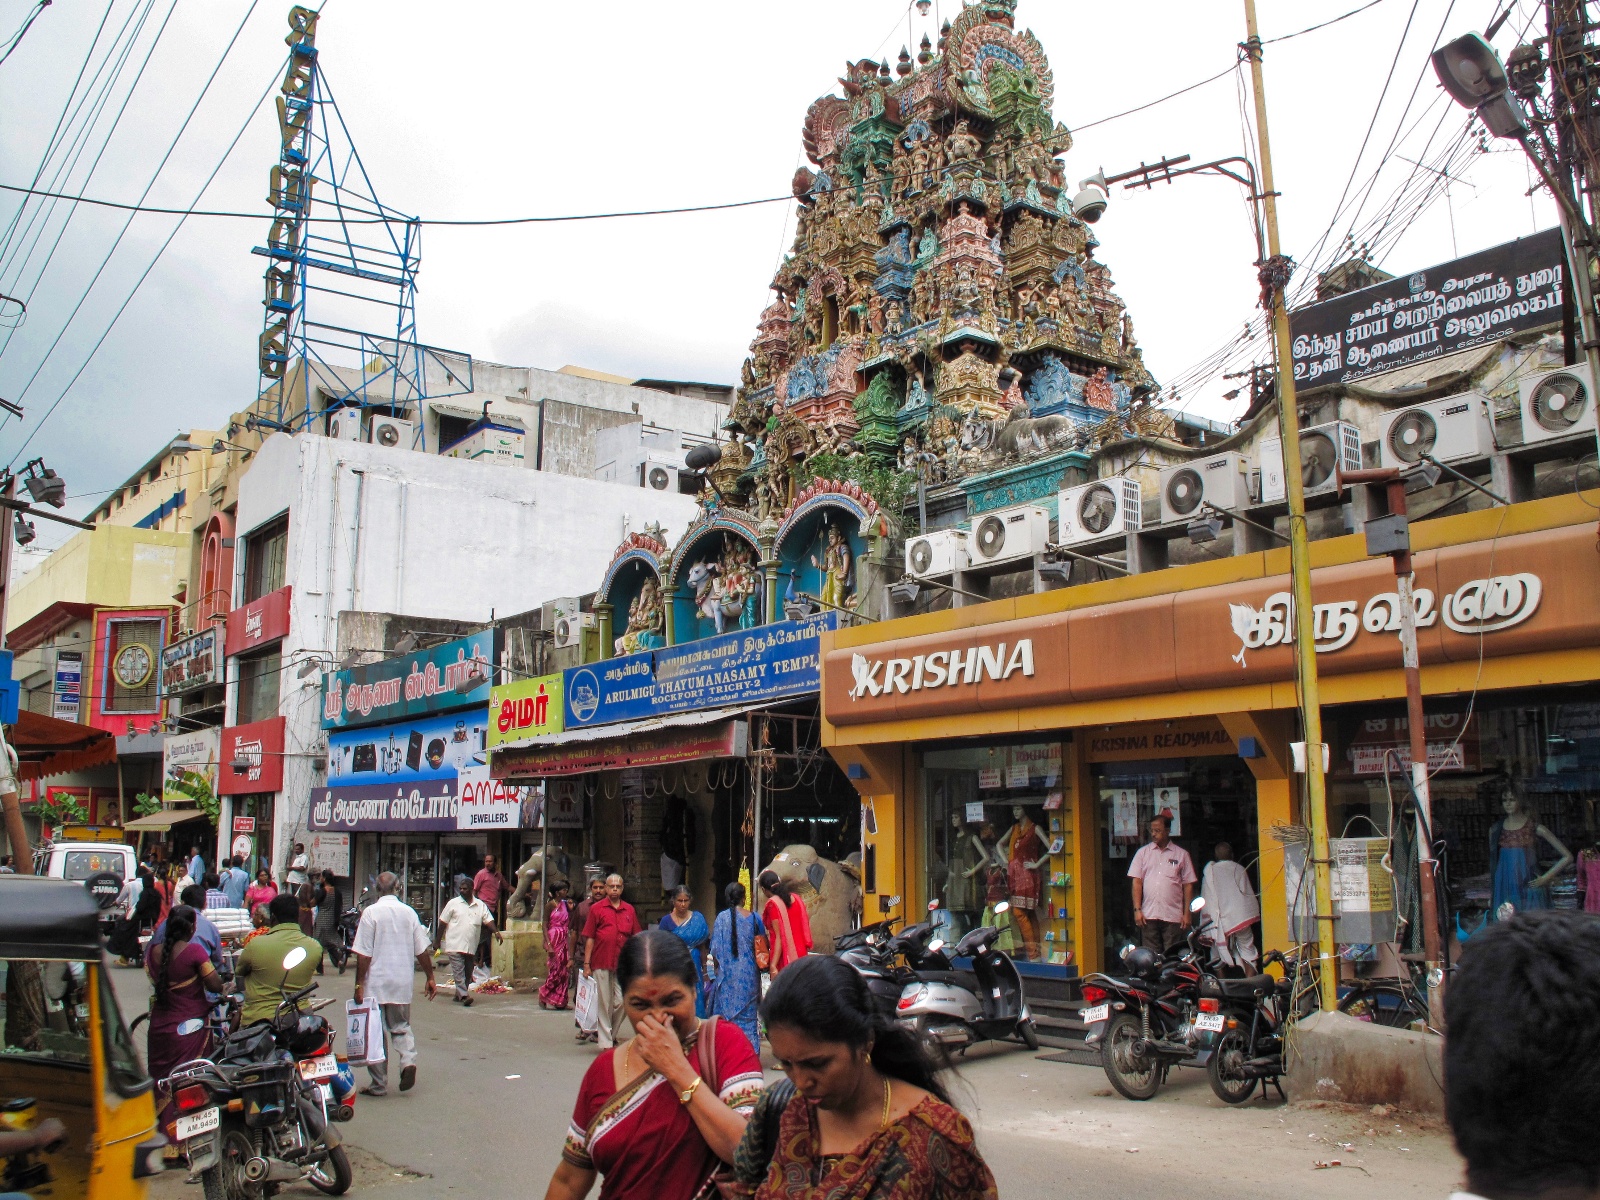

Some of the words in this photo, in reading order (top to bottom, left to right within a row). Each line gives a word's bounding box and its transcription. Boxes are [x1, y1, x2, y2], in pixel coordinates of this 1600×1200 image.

[1292, 331, 1342, 360] இந்து
[1345, 317, 1388, 344] சமய
[1392, 276, 1512, 329] அறநிலையத்
[1350, 289, 1436, 325] தமிழ்நாடு
[1442, 272, 1493, 293] அரசு
[1293, 350, 1342, 382] உதவி
[1346, 321, 1440, 367] ஆணையர்
[1340, 344, 1443, 383] திருச்சிராப்பள்ளி
[1456, 336, 1485, 349] 620
[1486, 328, 1516, 340] 002
[603, 660, 650, 681] அருள்மிகு
[742, 620, 828, 656] திருக்கோயில்
[850, 638, 1035, 700] KRISHNA
[324, 678, 343, 720] ஸ்ரீ
[346, 676, 402, 717] அருணா
[604, 684, 656, 705] ARULMIGU
[659, 662, 767, 695] THAYUMANASAMY
[651, 688, 704, 705] ROCKFORT
[708, 679, 761, 695] TRICHY-2
[497, 683, 549, 734] அமர்
[1091, 735, 1148, 752] KRISHNA
[1153, 729, 1233, 749] READYMAD
[248, 767, 261, 781] SHOP
[461, 780, 520, 806] AMAR
[313, 790, 332, 827] ஸ்ரீ
[333, 797, 390, 827] அருணா
[470, 812, 509, 825] JEWELLERS
[91, 885, 118, 894] SUMO
[186, 1117, 218, 1133] AM.9490
[191, 1110, 213, 1123] TN.45
